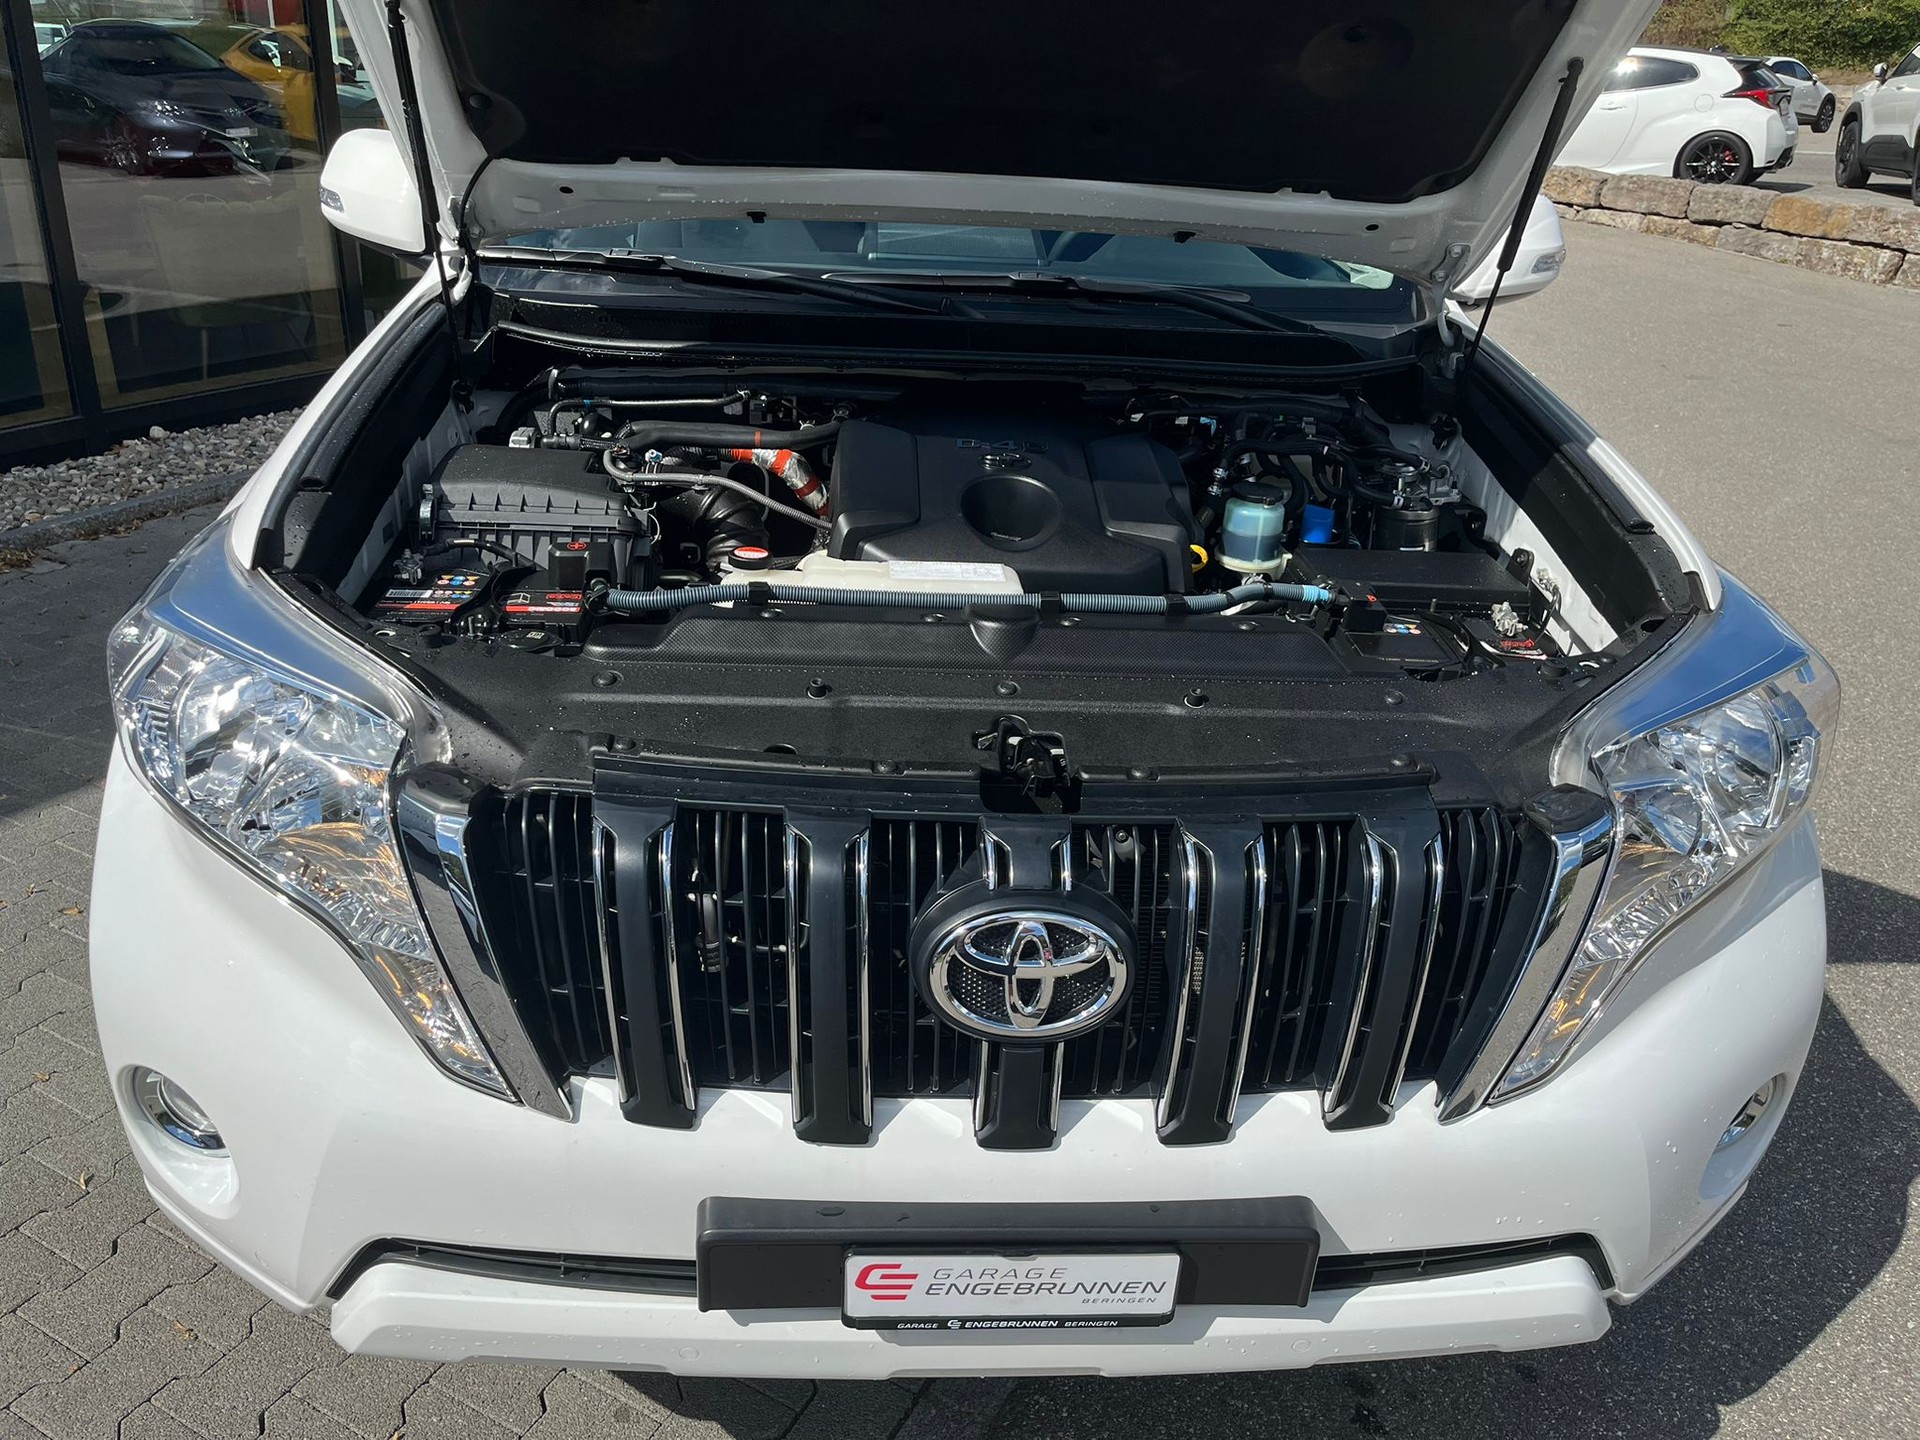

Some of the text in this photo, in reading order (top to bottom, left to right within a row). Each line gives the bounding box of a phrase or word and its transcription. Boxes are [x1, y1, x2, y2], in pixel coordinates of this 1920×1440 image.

[933, 1267, 1068, 1280] GARAGE
[924, 1281, 1167, 1296] ENGEBRUNNEN
[964, 1320, 1059, 1329] ENGEBRUNNEN
[1064, 1320, 1119, 1328] BERINGEN
